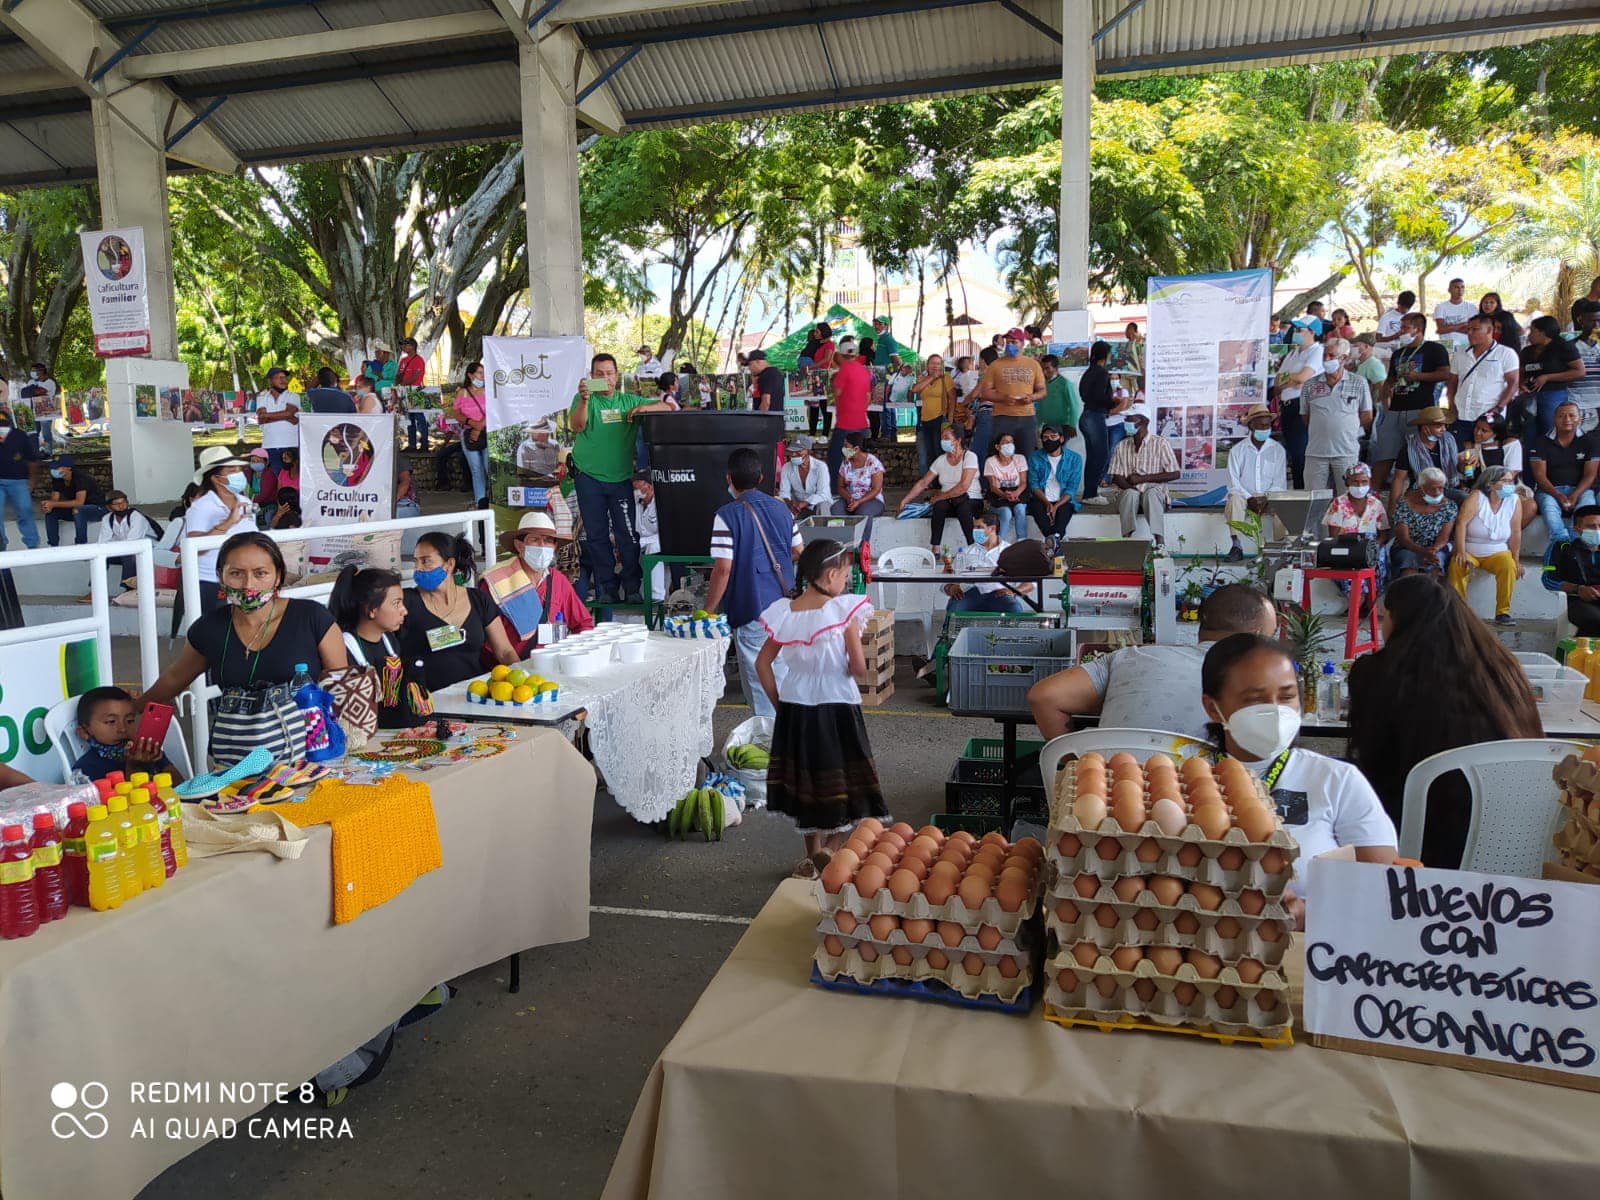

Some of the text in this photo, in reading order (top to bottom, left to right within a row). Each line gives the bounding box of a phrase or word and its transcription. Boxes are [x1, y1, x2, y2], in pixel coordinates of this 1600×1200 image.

[98, 282, 139, 293] Caficultura
[102, 292, 137, 304] Familiar
[317, 489, 378, 502] Caficultura
[320, 505, 374, 517] Familir
[1386, 866, 1554, 928] HUEVOS
[1420, 921, 1499, 958] CON
[1353, 994, 1596, 1068] ORGANICAS
